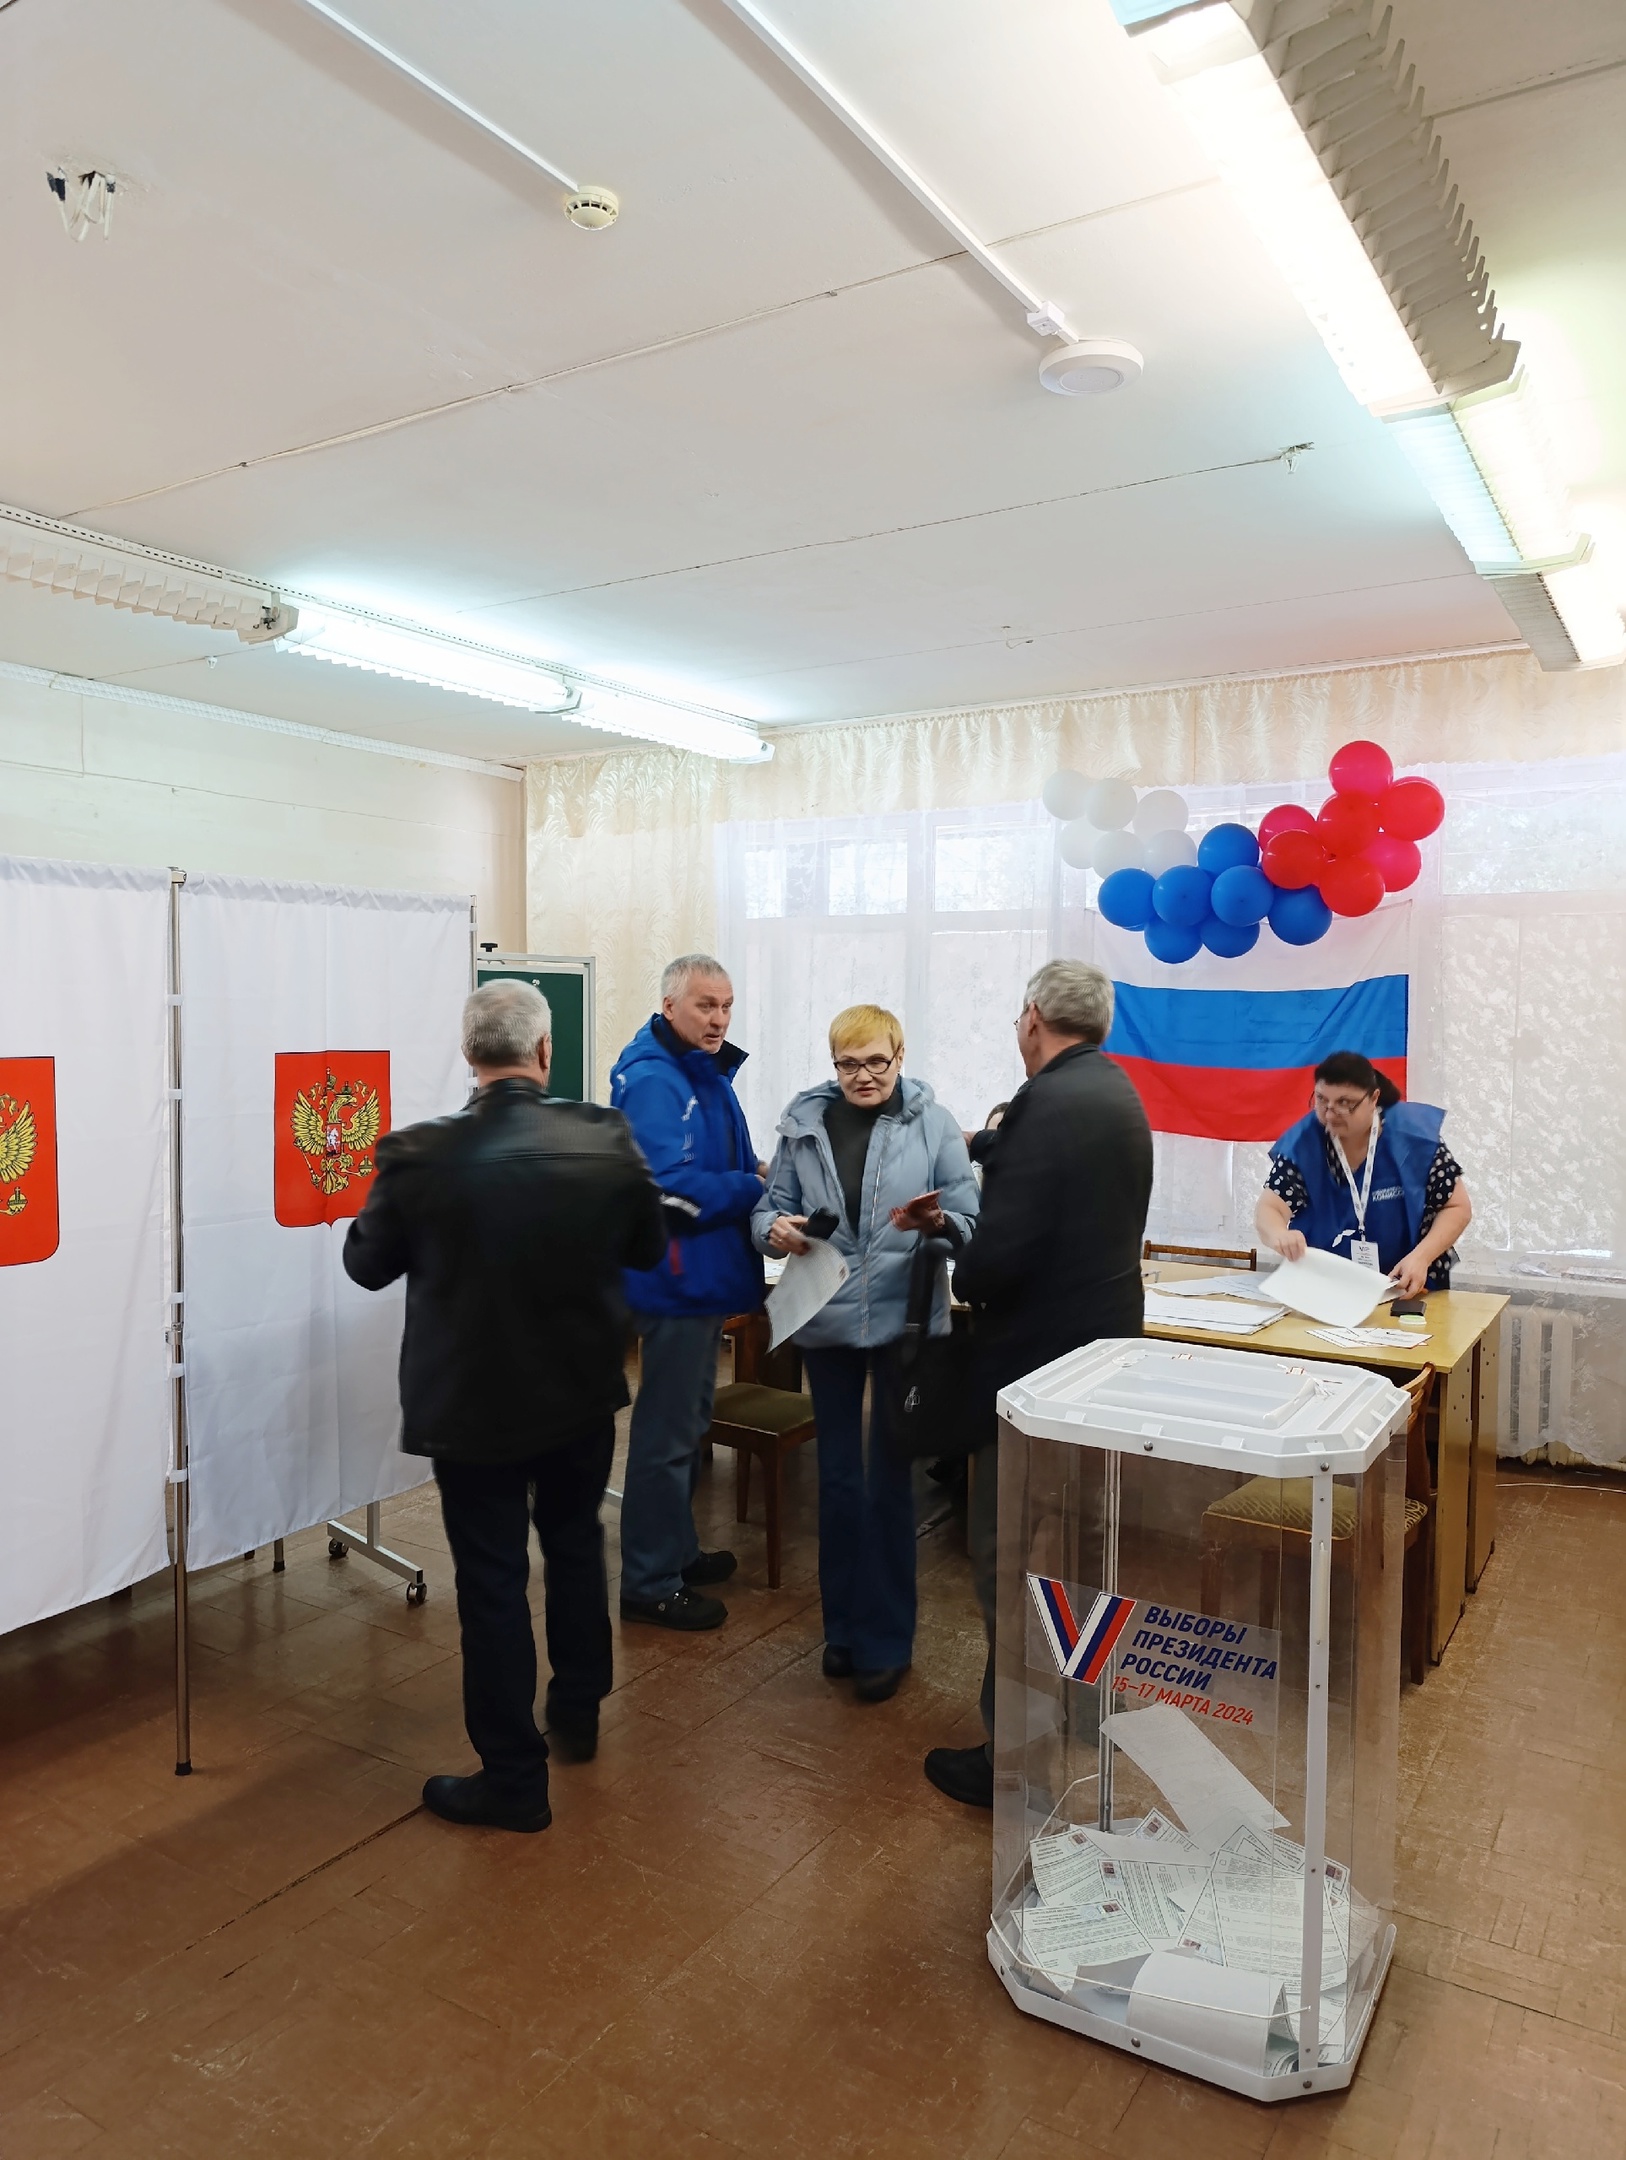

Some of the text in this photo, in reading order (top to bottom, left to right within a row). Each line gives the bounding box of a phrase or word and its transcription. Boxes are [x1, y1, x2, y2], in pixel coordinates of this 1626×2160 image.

[1144, 1606, 1248, 1644] ВЫБОРЫ
[1120, 1653, 1212, 1691] РОССИИ
[1132, 1629, 1278, 1680] ПРЕЗИДЕНТА
[1156, 1687, 1210, 1715] МАРТА
[1212, 1702, 1254, 1725] 2024
